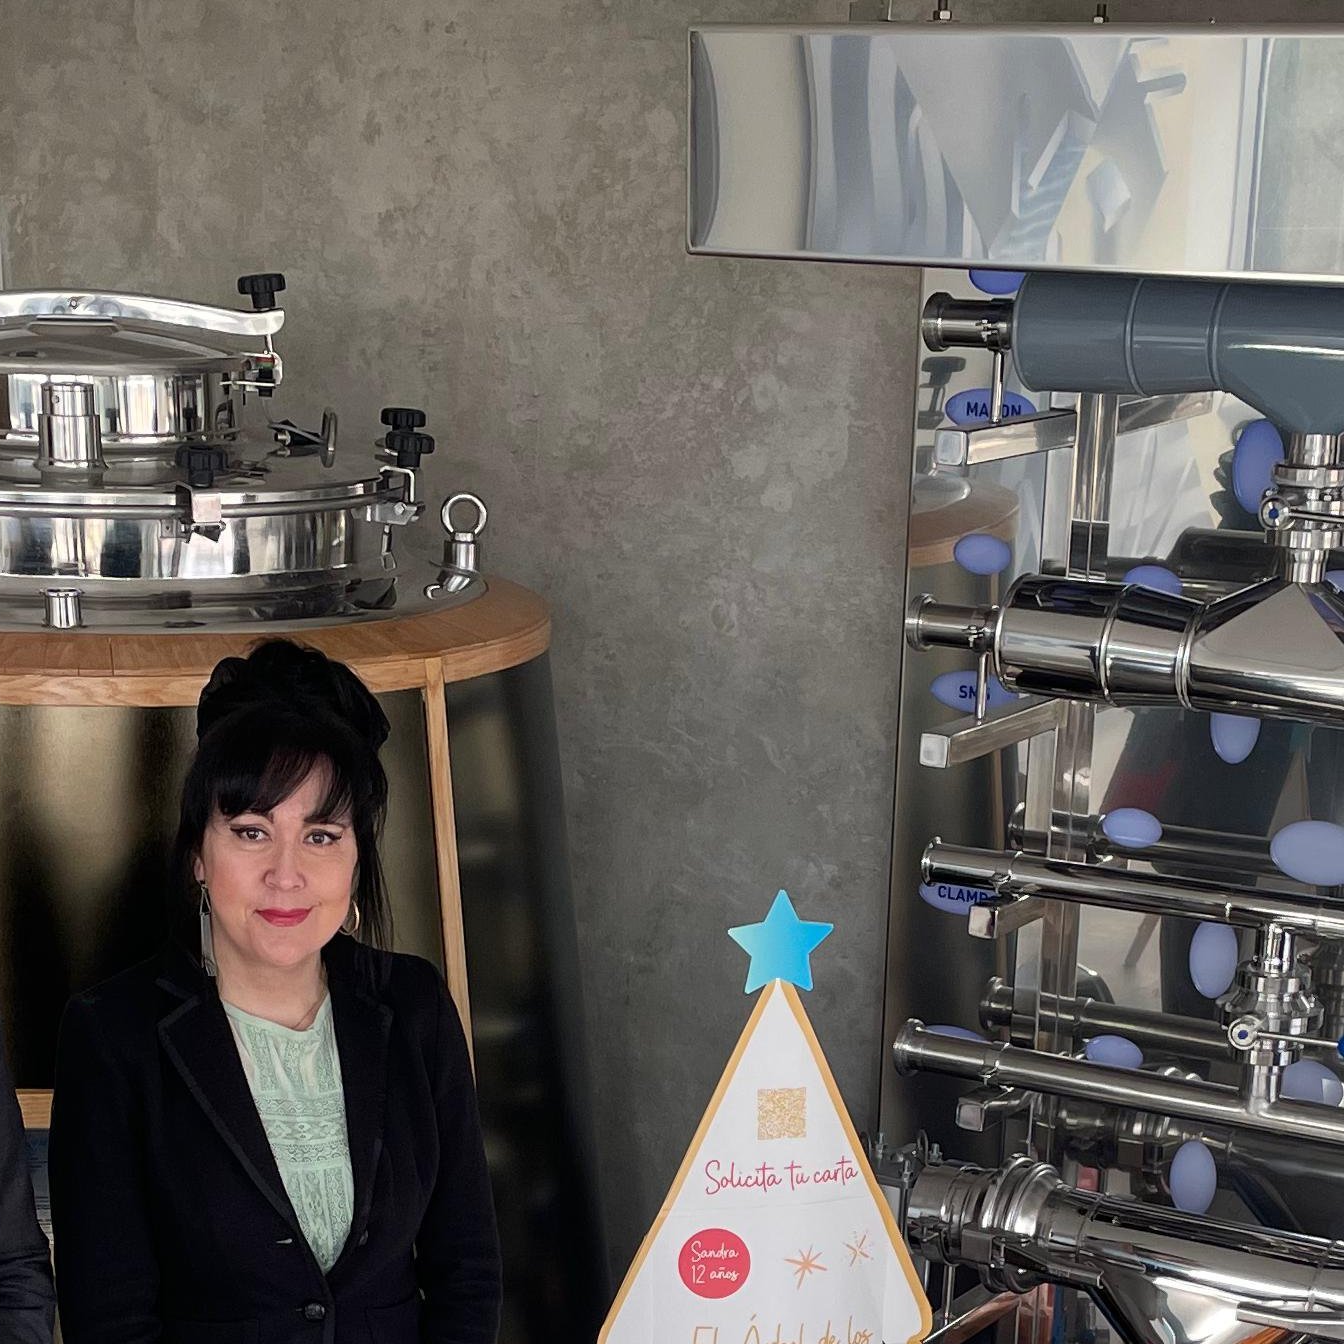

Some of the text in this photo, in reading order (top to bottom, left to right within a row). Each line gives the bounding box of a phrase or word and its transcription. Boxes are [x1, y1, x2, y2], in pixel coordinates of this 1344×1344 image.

[966, 401, 1022, 419] MAON
[705, 1155, 858, 1195] Solicita tu carta
[691, 1240, 739, 1263] Sandra
[691, 1264, 740, 1284] 12 años
